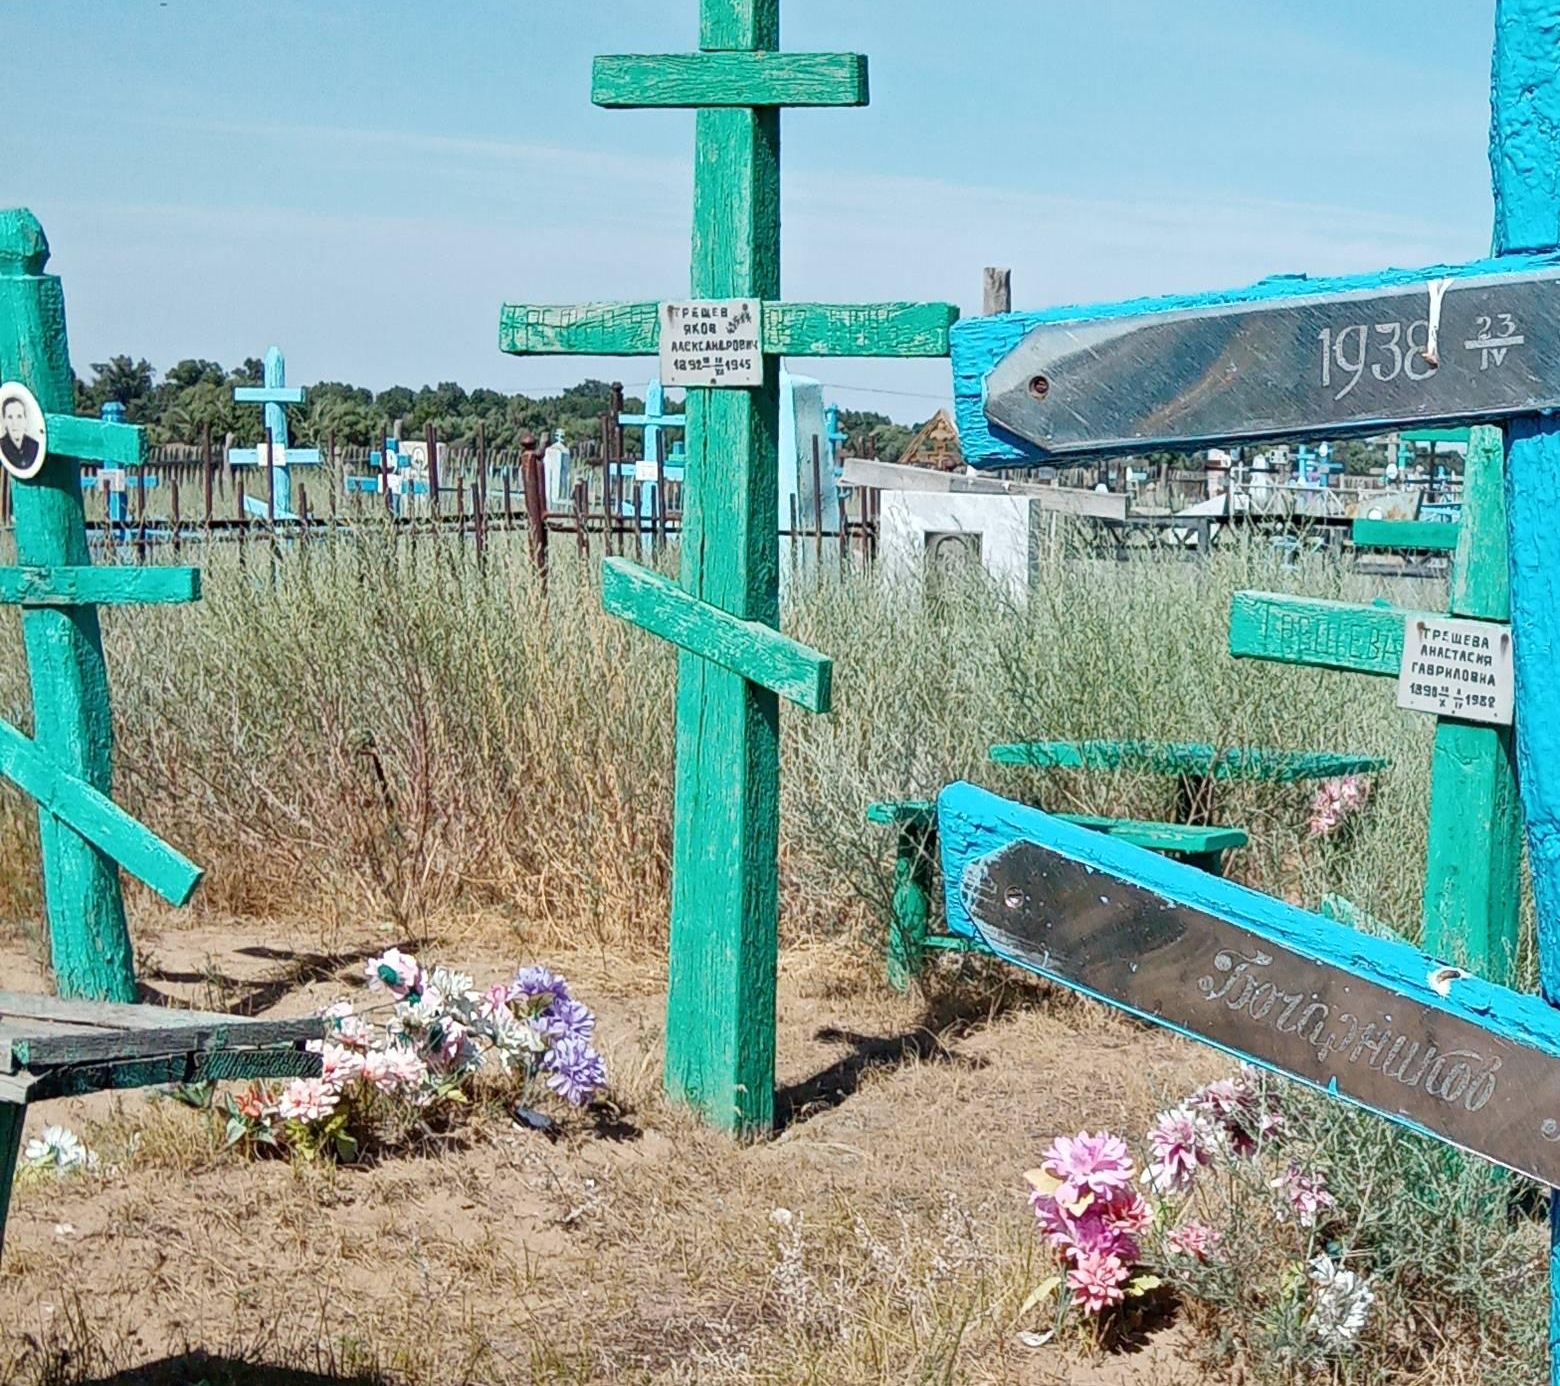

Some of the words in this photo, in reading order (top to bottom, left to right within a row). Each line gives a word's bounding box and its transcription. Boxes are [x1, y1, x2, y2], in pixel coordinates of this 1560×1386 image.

[683, 322, 717, 335] ЯКОВ
[671, 339, 758, 353] АЛЕКСАНДРОВИЧ
[725, 358, 751, 371] 1945
[1316, 319, 1440, 400] 1938
[1422, 627, 1489, 650] ТРЕЩЕВА
[1420, 644, 1492, 667] АНАСТАСИЯ
[1411, 661, 1496, 687] ГАВРИЛОВНА
